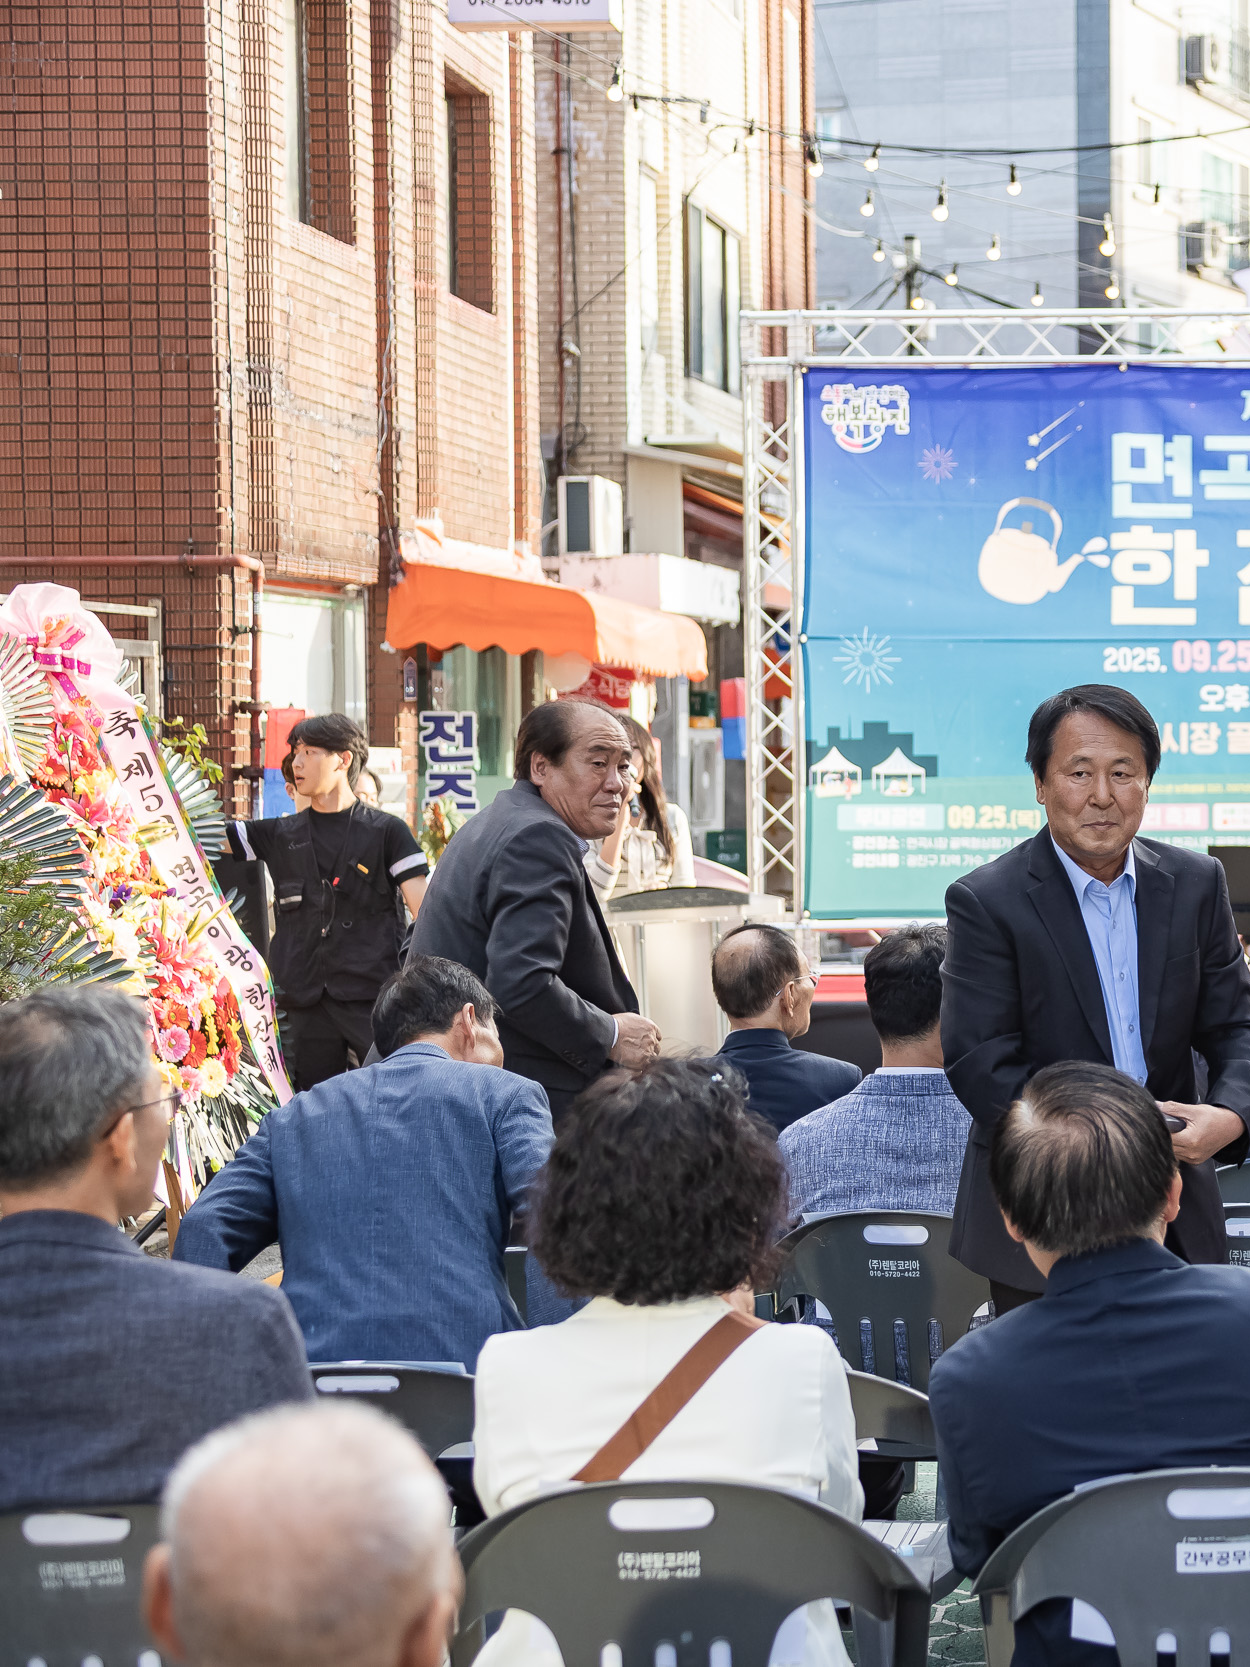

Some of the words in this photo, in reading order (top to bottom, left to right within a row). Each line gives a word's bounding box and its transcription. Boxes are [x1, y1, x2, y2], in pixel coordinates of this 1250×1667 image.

[1110, 524, 1210, 626] 한
[1103, 646, 1168, 673] 2025.
[1198, 683, 1250, 712] 오후
[104, 709, 140, 741] 축
[169, 855, 254, 972] 면곡이랑
[868, 1259, 920, 1271] (주)렌탈코리아
[869, 1270, 921, 1278] 010-5720-4422
